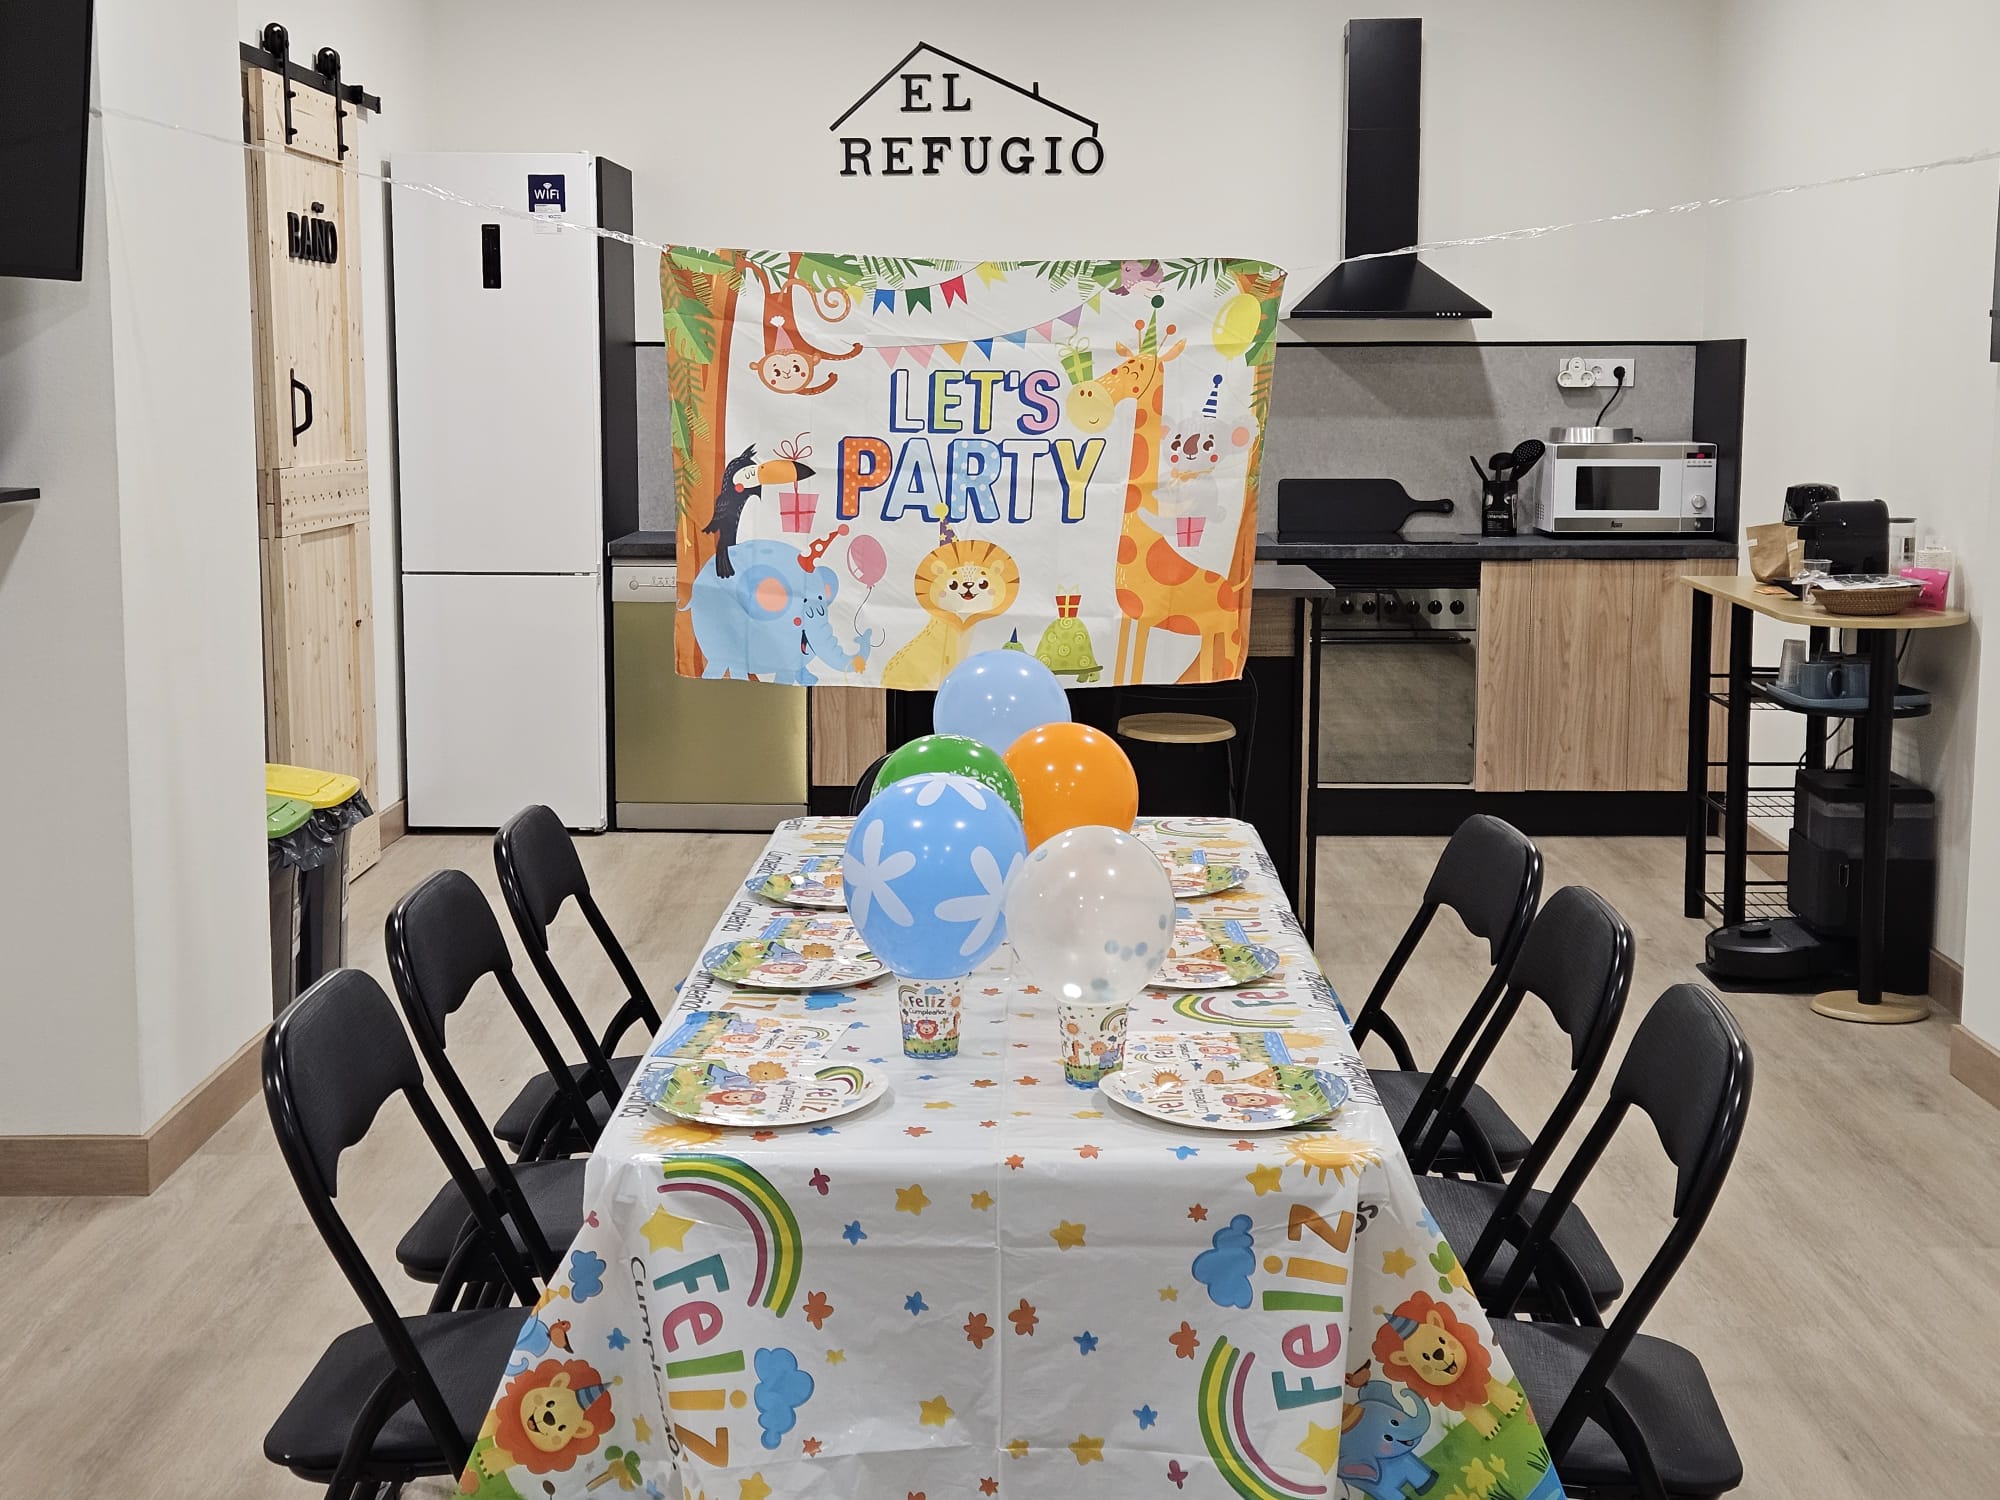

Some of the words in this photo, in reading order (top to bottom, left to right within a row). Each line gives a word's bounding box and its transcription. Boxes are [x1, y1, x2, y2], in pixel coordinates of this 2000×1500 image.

[900, 73, 971, 112] EL
[839, 136, 1104, 176] REFUGIO
[890, 369, 1060, 435] LET'S
[836, 436, 1107, 524] PARTY
[908, 996, 945, 1008] Feliz
[1263, 1204, 1355, 1411] Feliz
[653, 1254, 748, 1468] Feliz
